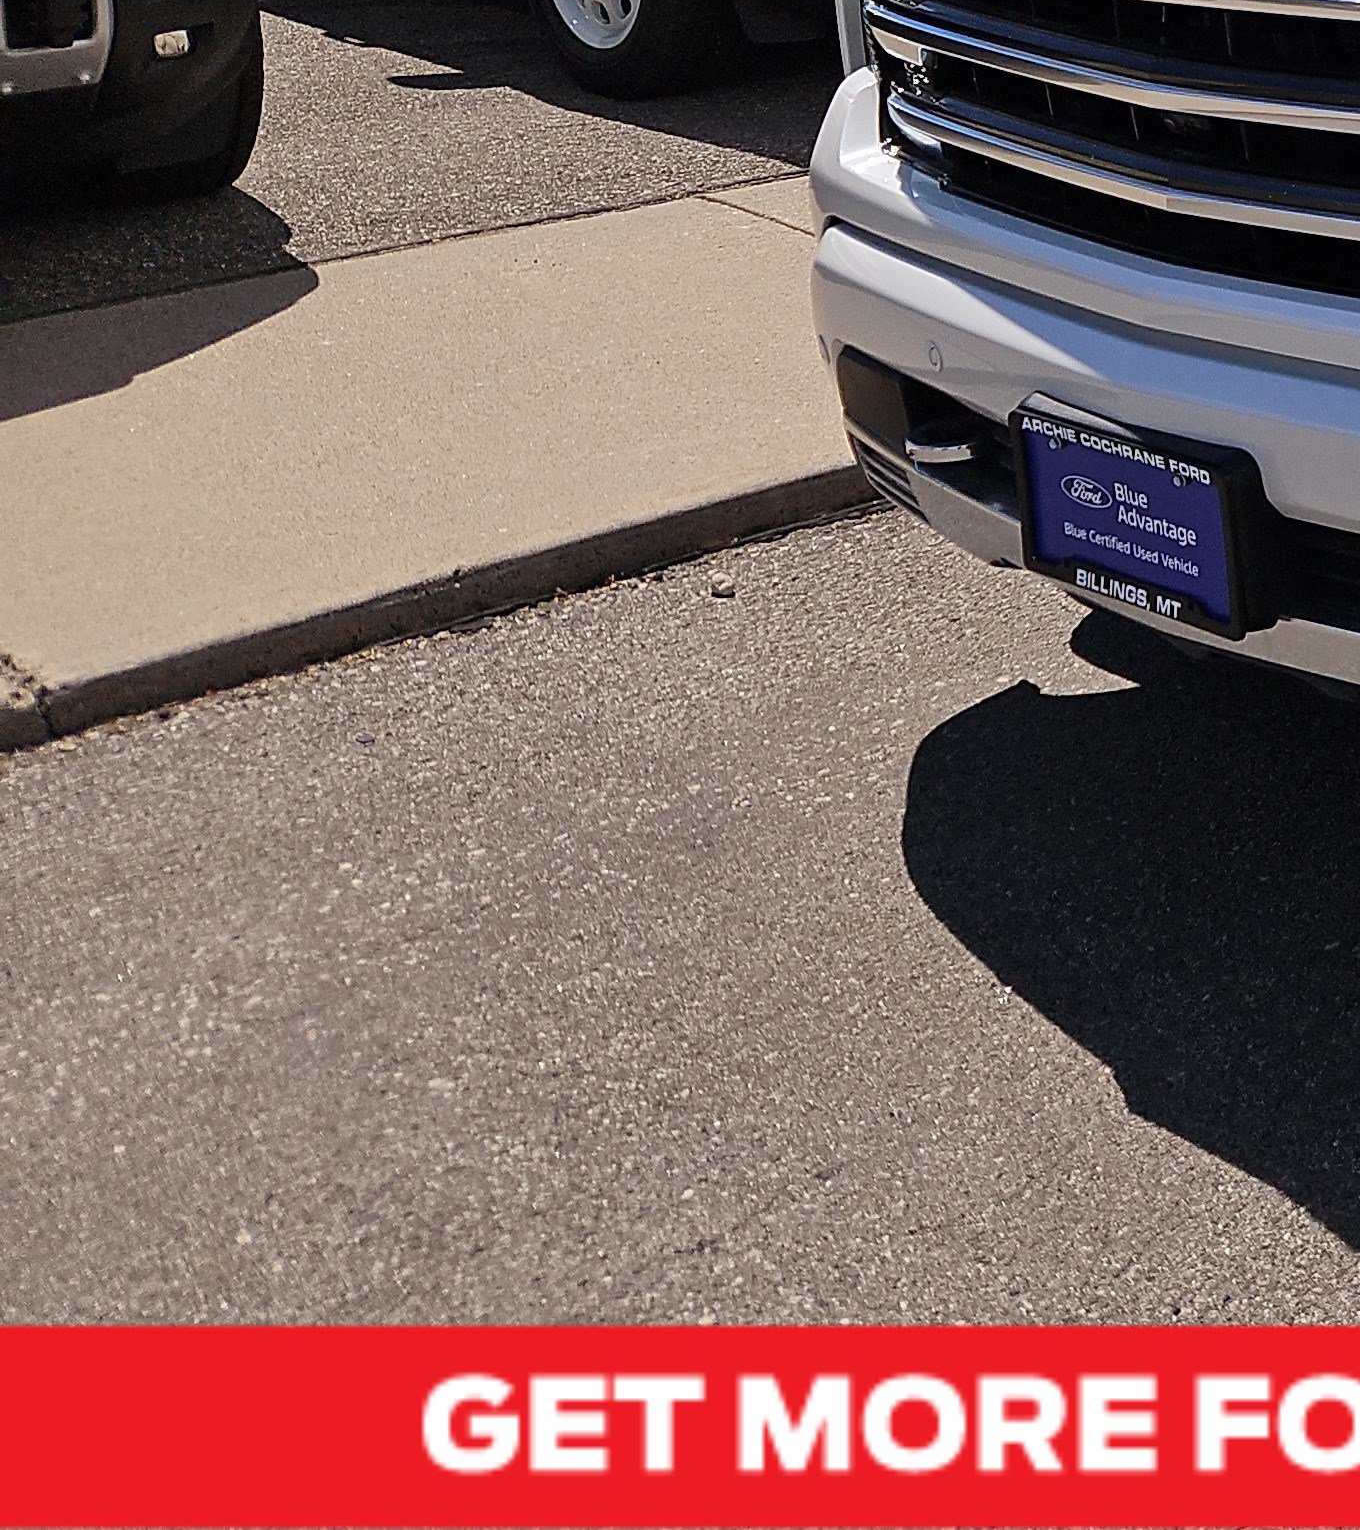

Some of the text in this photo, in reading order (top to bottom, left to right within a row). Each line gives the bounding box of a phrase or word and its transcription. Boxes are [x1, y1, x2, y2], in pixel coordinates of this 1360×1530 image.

[1021, 416, 1211, 486] ARCHIE COCHRANE FORD
[1069, 479, 1104, 506] Ford
[1113, 482, 1149, 509] Blue
[1117, 504, 1198, 547] Advantage
[1063, 521, 1200, 578] Blue Certified Used Vehicle
[1075, 568, 1183, 619] BILLINGS, MT
